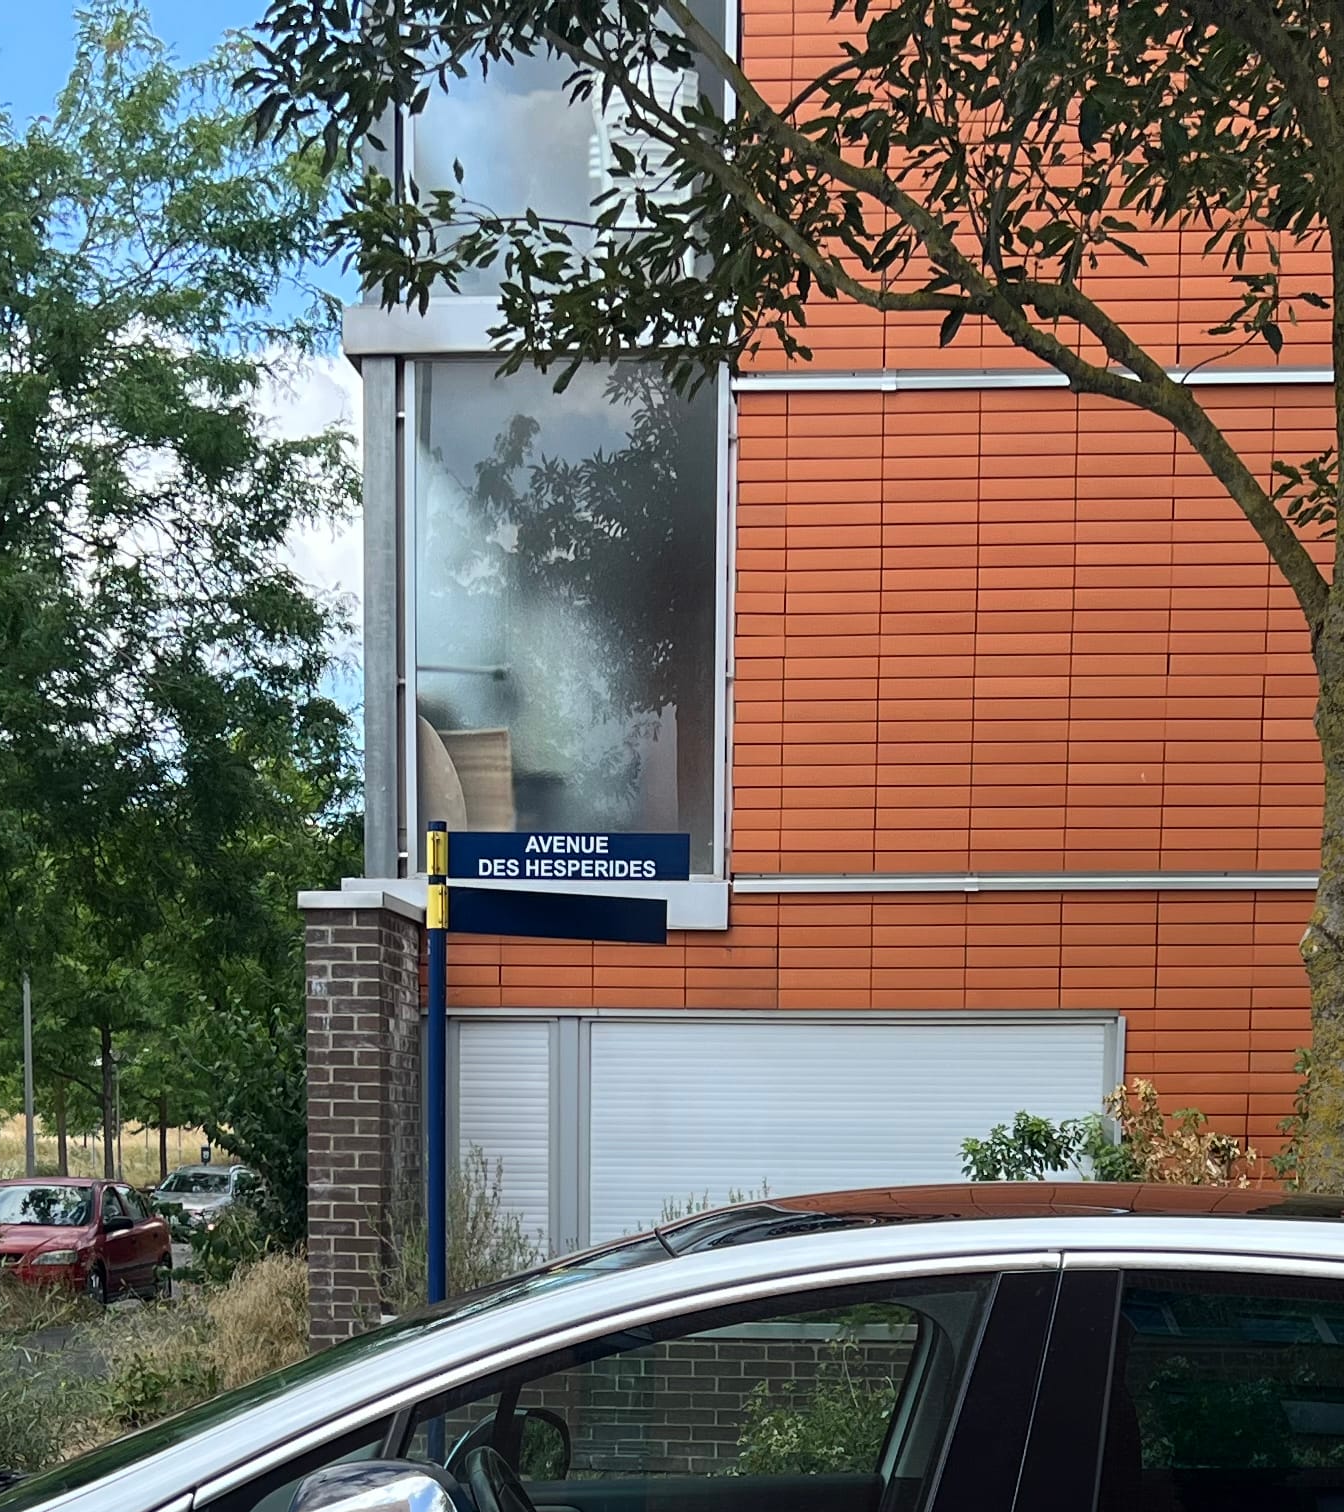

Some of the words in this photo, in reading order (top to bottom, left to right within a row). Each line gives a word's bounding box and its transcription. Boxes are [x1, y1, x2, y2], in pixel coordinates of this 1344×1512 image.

[524, 835, 609, 854] AVENUE
[478, 858, 520, 877] DES
[525, 859, 656, 878] HESPERIDES
